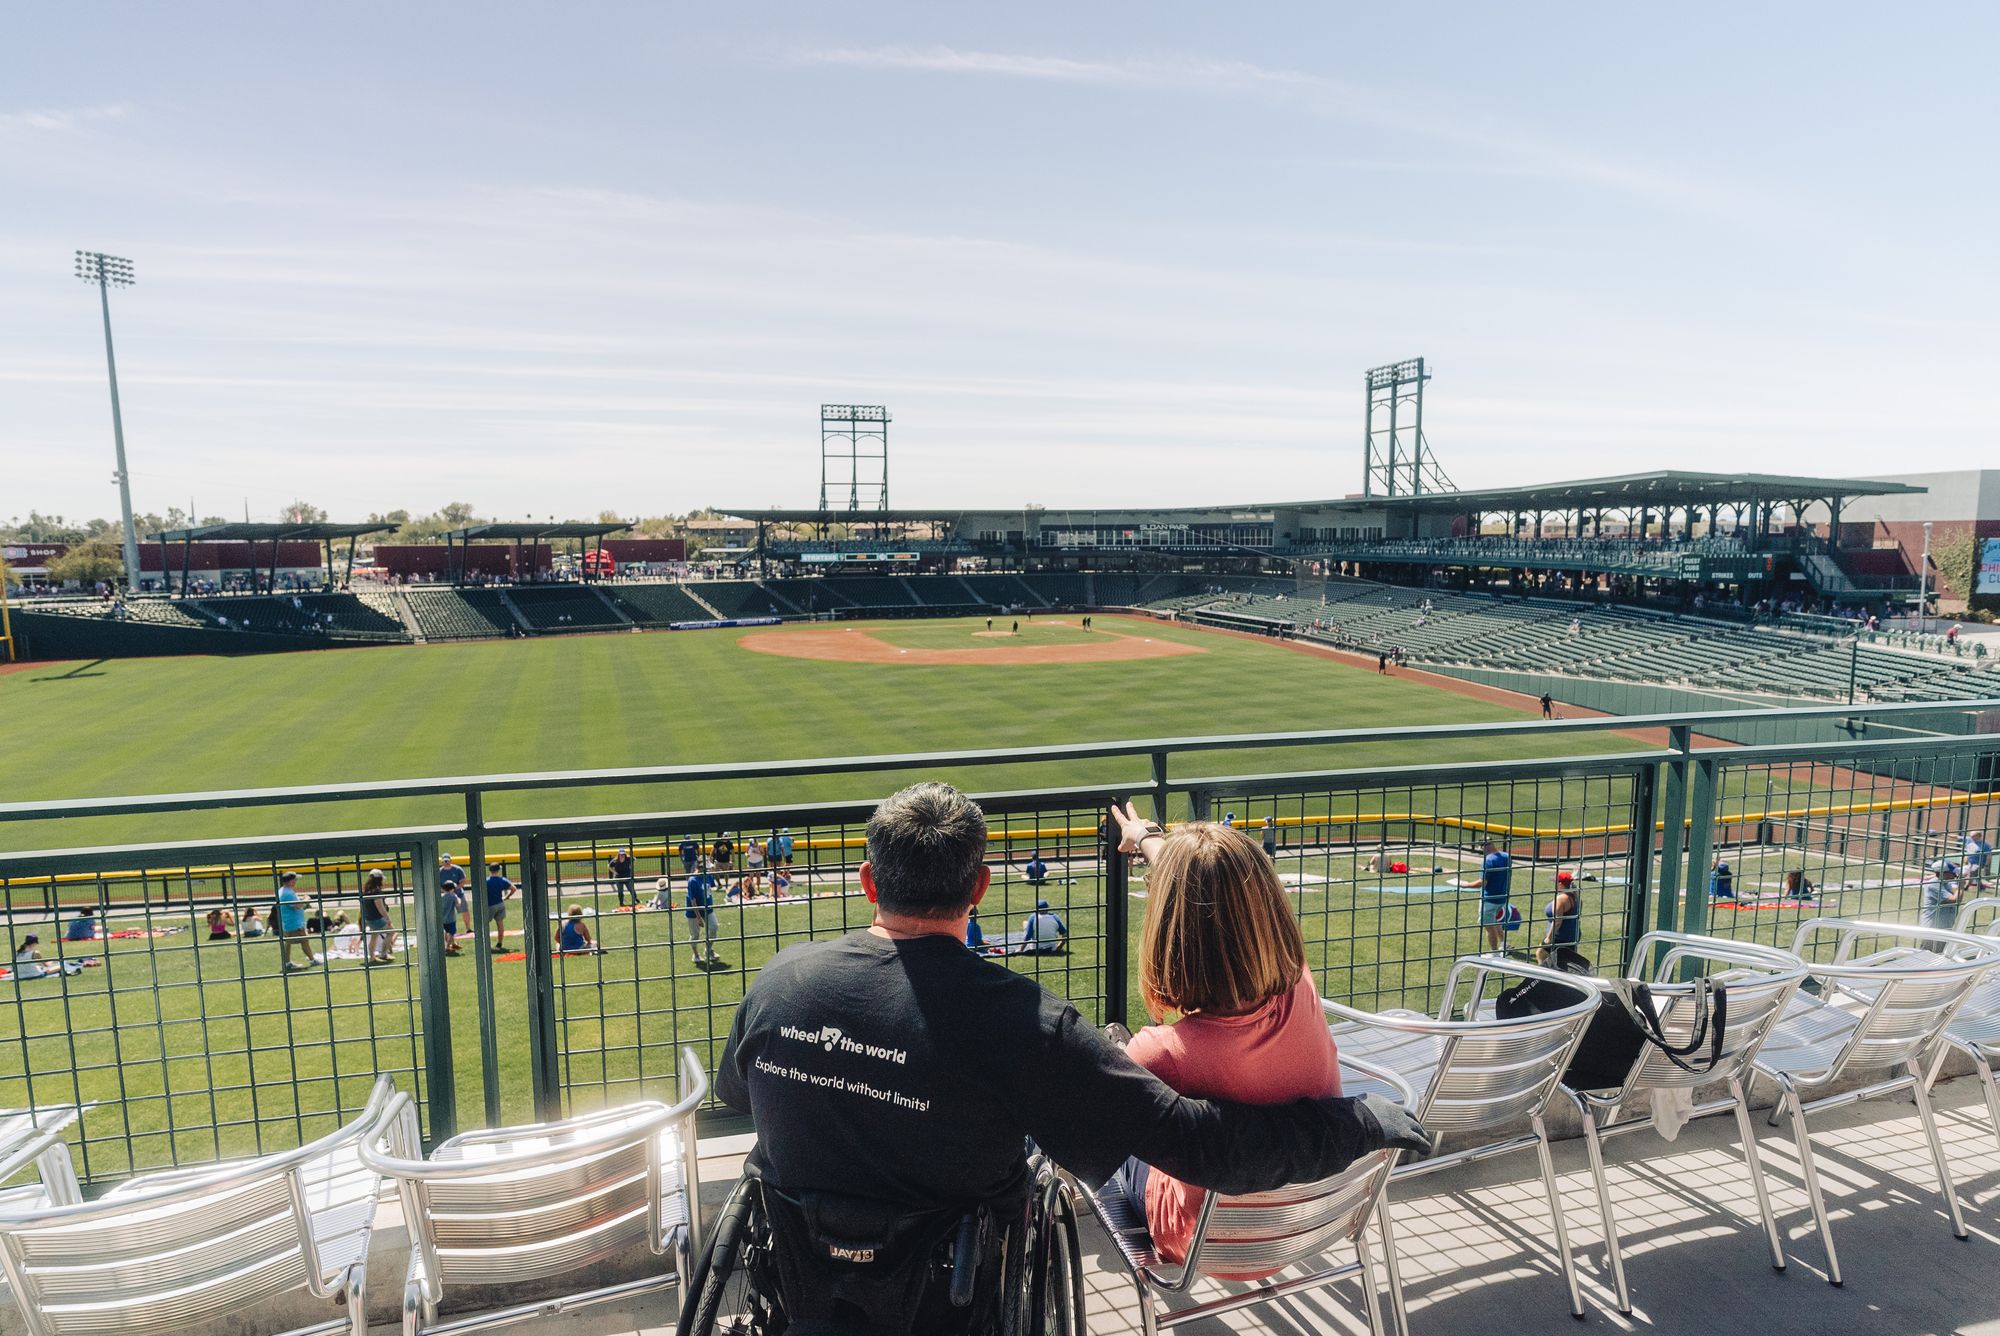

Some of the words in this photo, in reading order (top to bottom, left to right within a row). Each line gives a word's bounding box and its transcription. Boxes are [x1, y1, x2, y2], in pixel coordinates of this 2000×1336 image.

[780, 1025, 819, 1044] wheel
[840, 1036, 864, 1054] the
[865, 1044, 907, 1065] world
[755, 1056, 787, 1077] Explore
[789, 1067, 808, 1082] the
[810, 1074, 844, 1089] world
[846, 1081, 891, 1101] without
[893, 1092, 930, 1112] limits!
[831, 1247, 853, 1259] JAY
